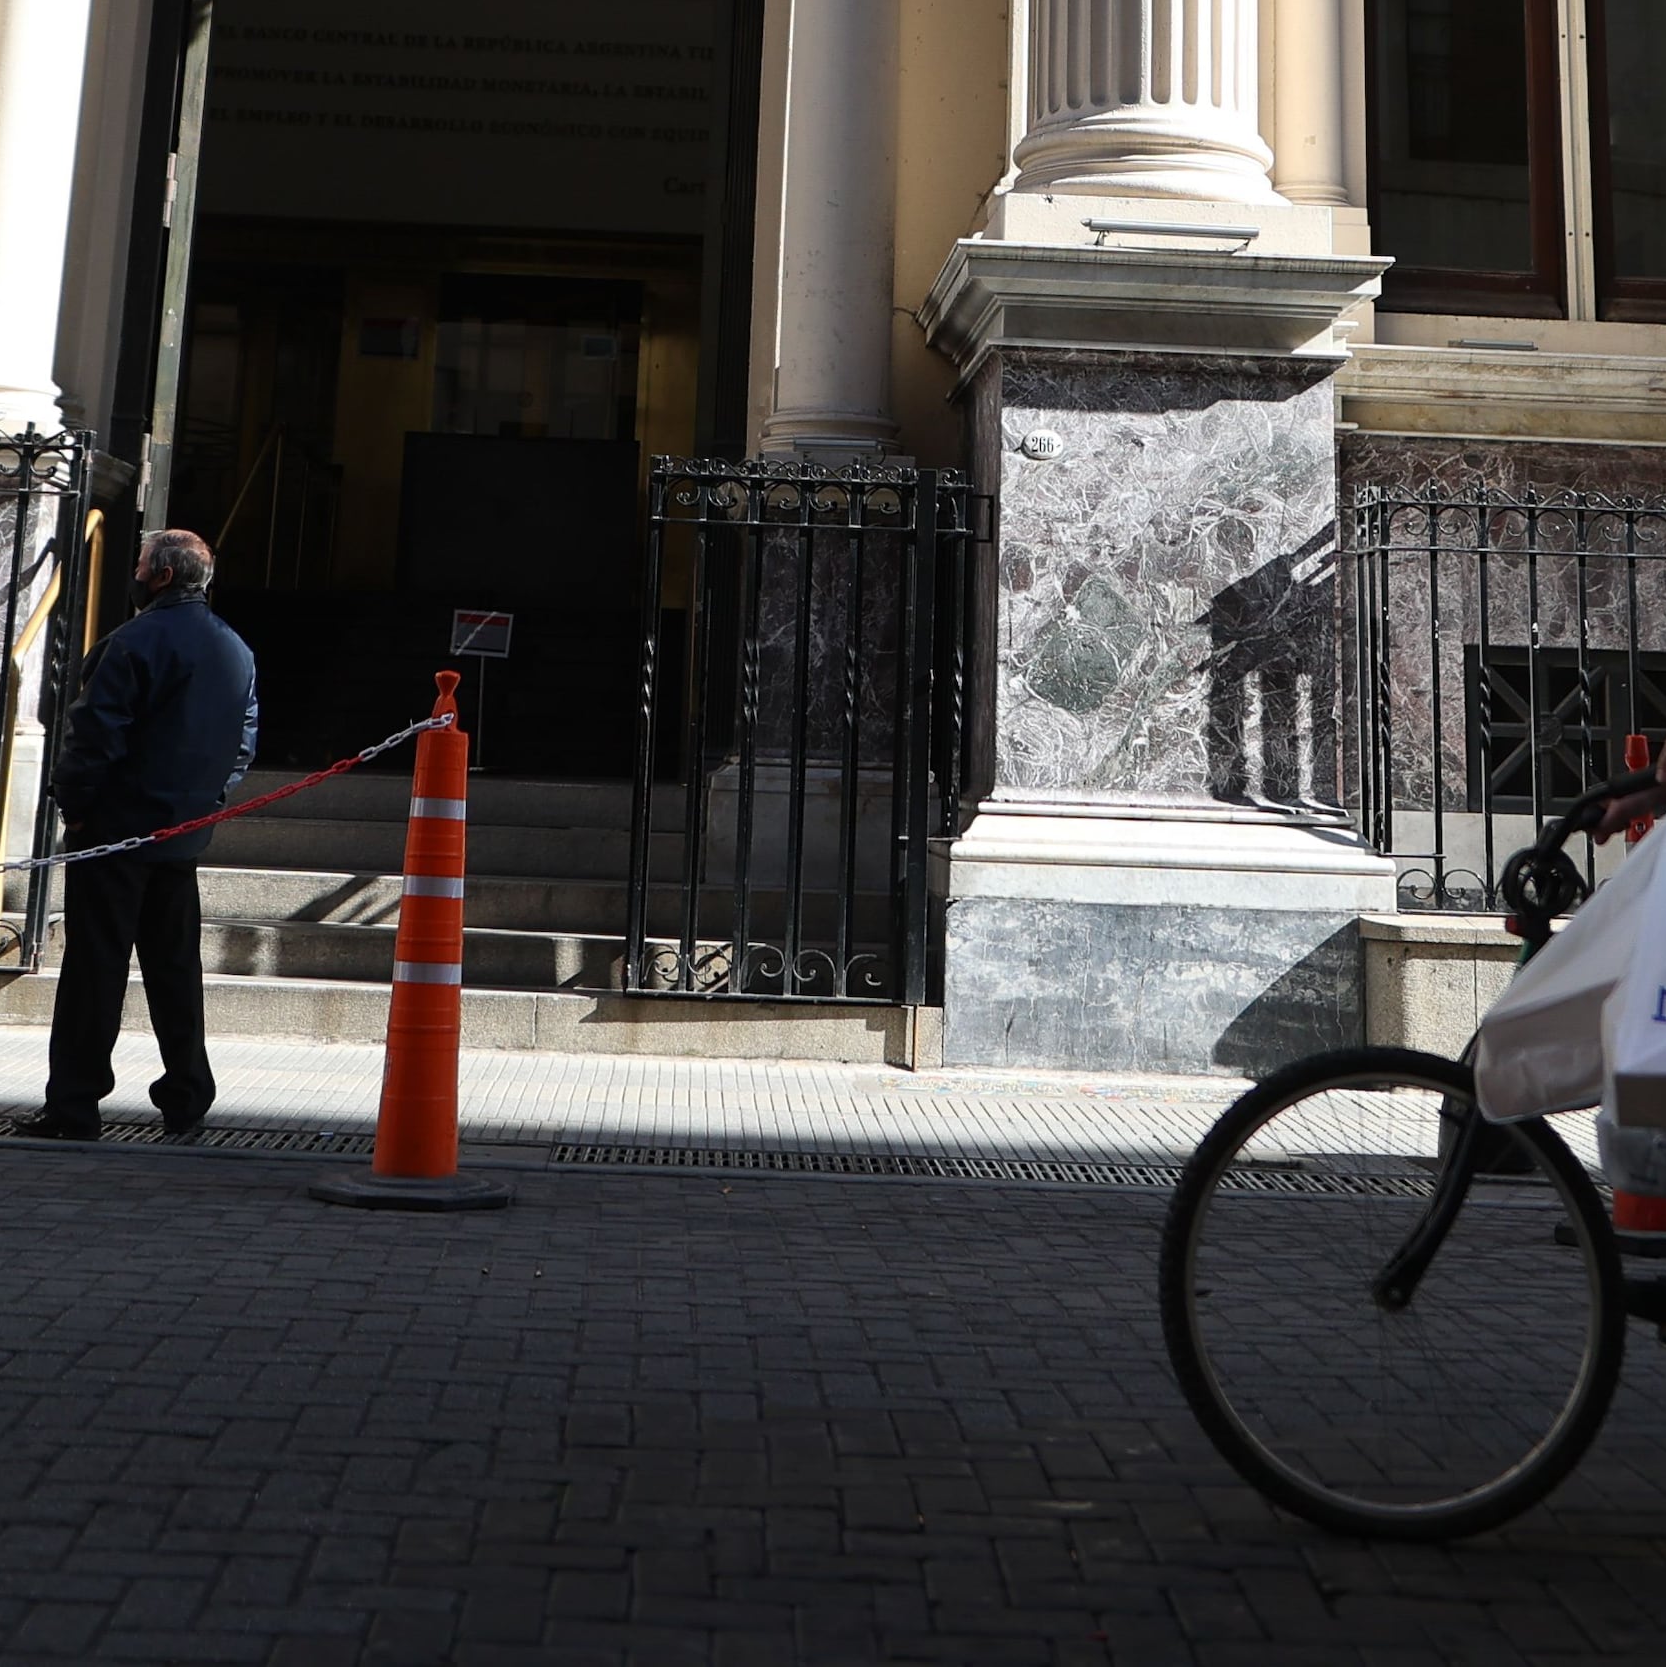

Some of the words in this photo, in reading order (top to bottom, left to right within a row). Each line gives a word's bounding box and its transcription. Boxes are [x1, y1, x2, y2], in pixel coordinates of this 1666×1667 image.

[242, 26, 308, 42] BANCO
[313, 30, 399, 46] CENTRAL
[404, 33, 428, 48] DE
[434, 35, 457, 49] LA
[573, 40, 682, 61] ARGENTINA
[213, 65, 318, 85] PROMOVER
[322, 71, 346, 86] LA
[352, 72, 477, 92] ESTABILIDAD
[602, 83, 627, 98] LA
[210, 107, 229, 122] EL
[236, 108, 312, 126] EMPLEO
[316, 112, 329, 127] Y
[333, 113, 356, 127] EL
[361, 114, 484, 133] DESARROLLO
[607, 126, 646, 140] CON
